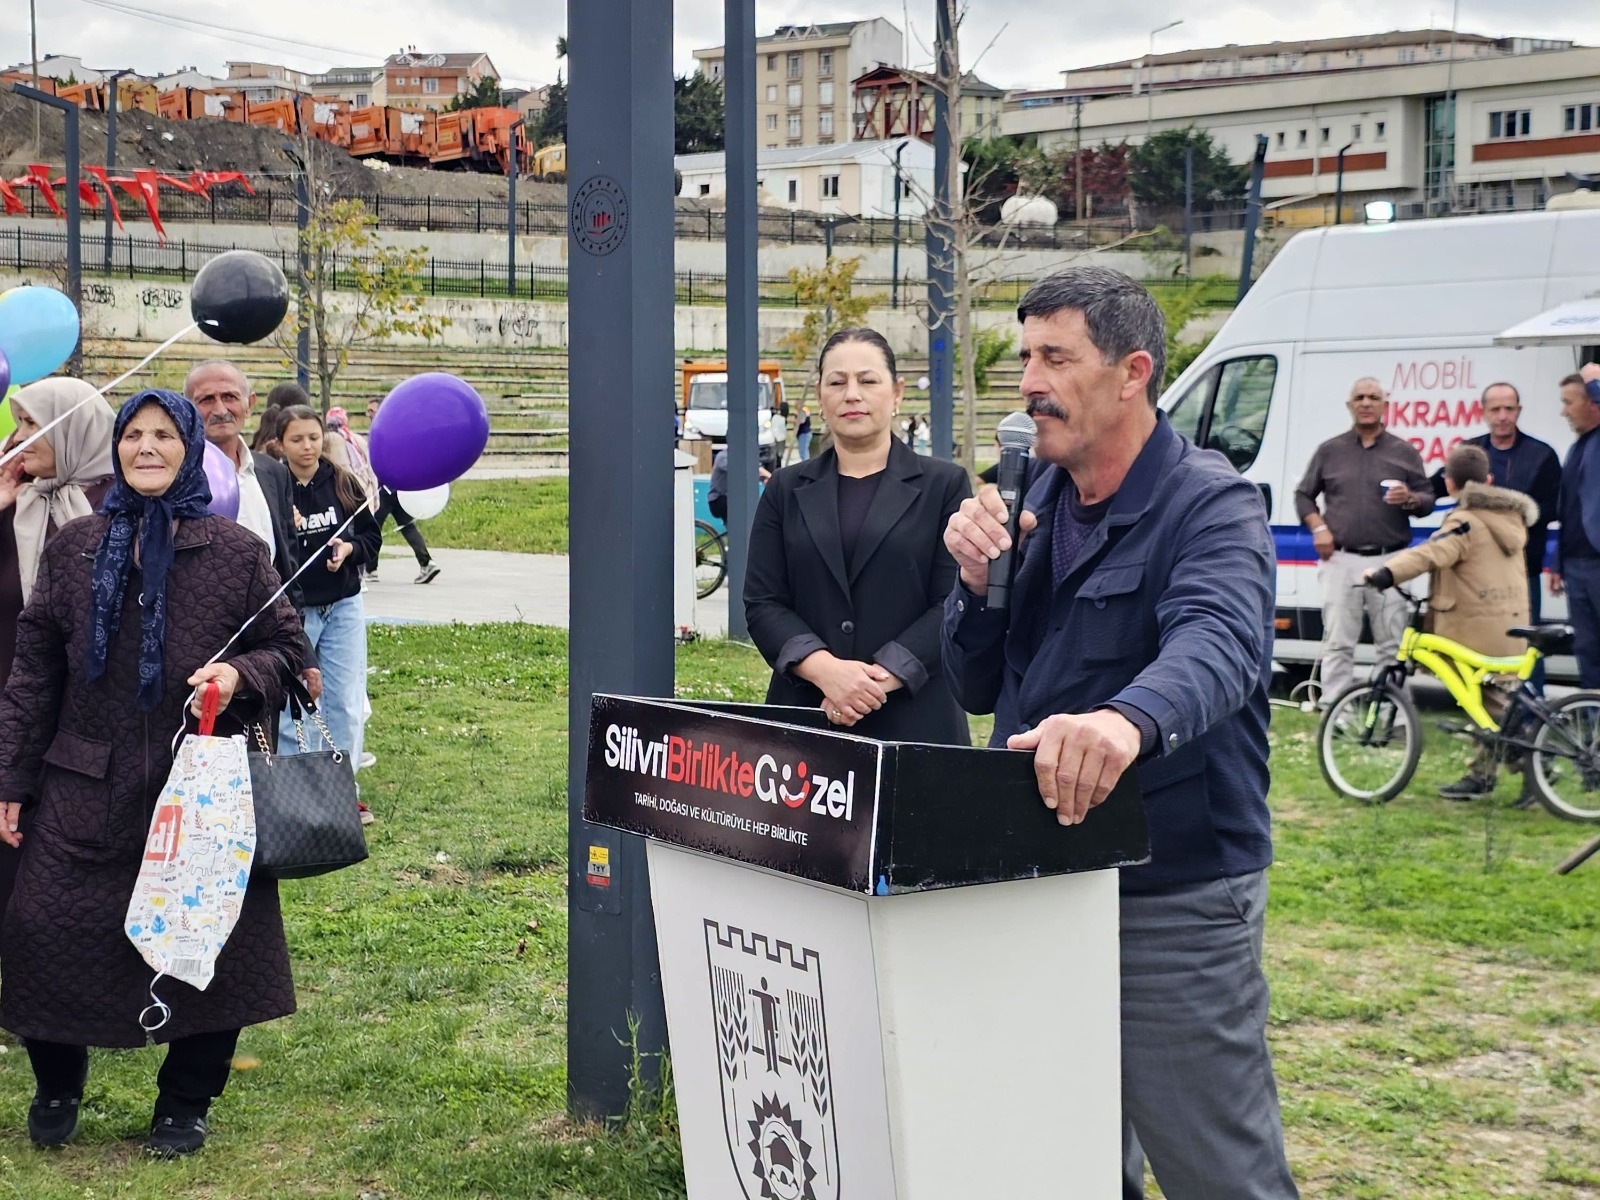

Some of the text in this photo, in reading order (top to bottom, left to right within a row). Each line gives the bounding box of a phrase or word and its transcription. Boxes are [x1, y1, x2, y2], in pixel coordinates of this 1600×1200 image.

[1392, 355, 1476, 390] MOBİL
[634, 792, 809, 846] TARİHİ, DOĞASI VE KÜLTÜRÜYLE HEP BİRLİKTE
